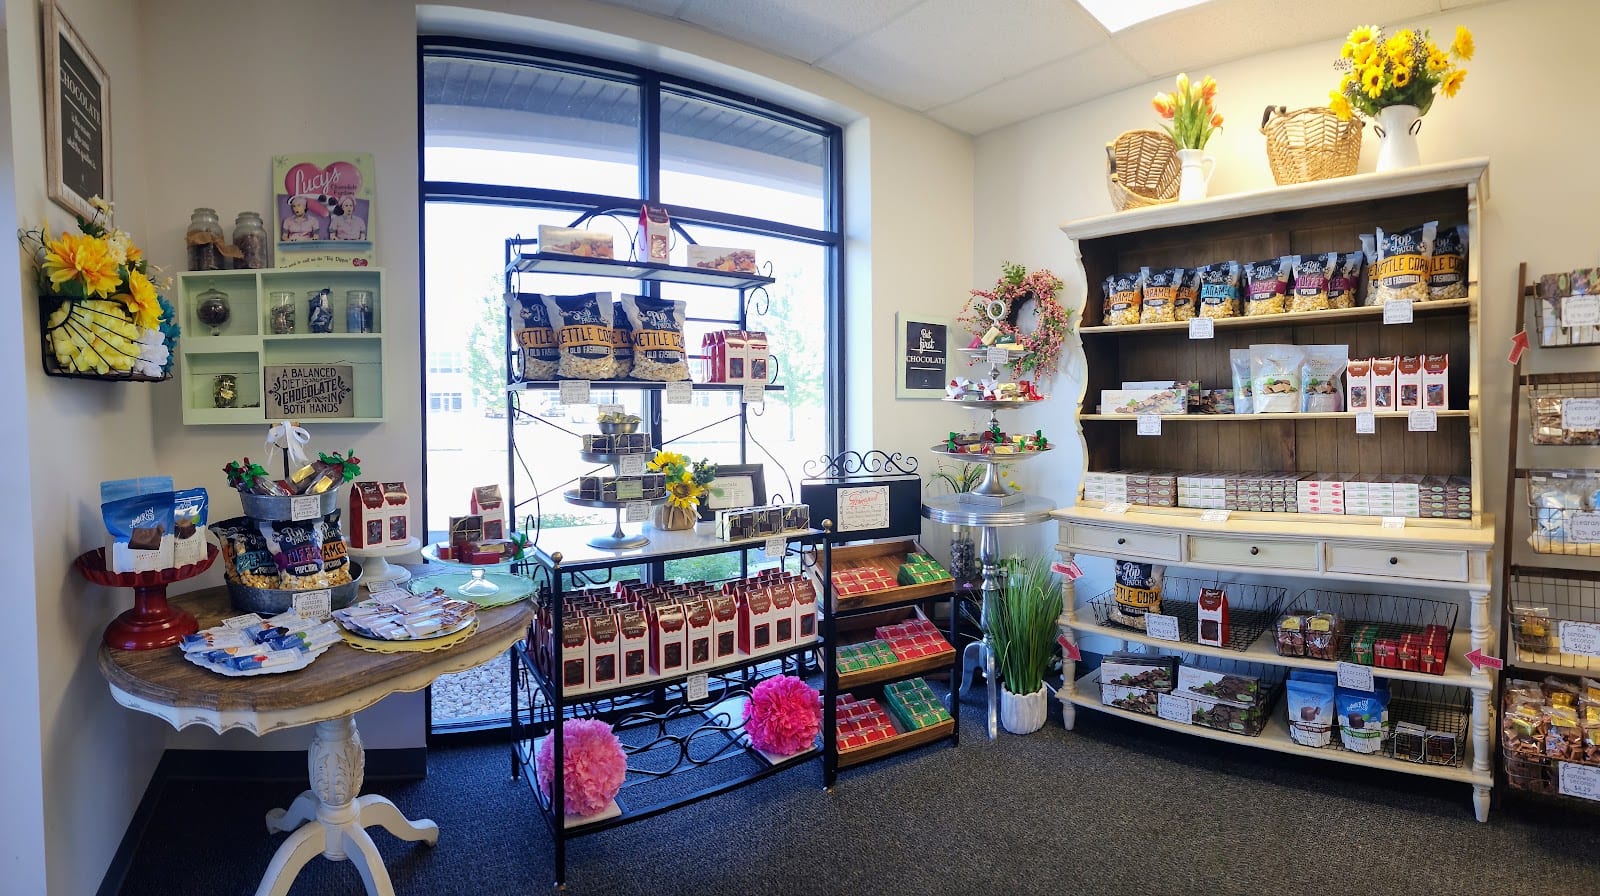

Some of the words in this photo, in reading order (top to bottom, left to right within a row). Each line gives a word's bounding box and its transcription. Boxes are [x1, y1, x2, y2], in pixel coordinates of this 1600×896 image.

[906, 355, 946, 365] CHOCOLATE
[282, 368, 288, 378] A
[291, 367, 337, 378] BALANCED
[282, 379, 300, 391] DIET
[282, 379, 337, 404] CHOCOLATE
[283, 404, 306, 415] BOTH
[309, 403, 339, 414] HANDS
[1122, 561, 1141, 581] Pop
